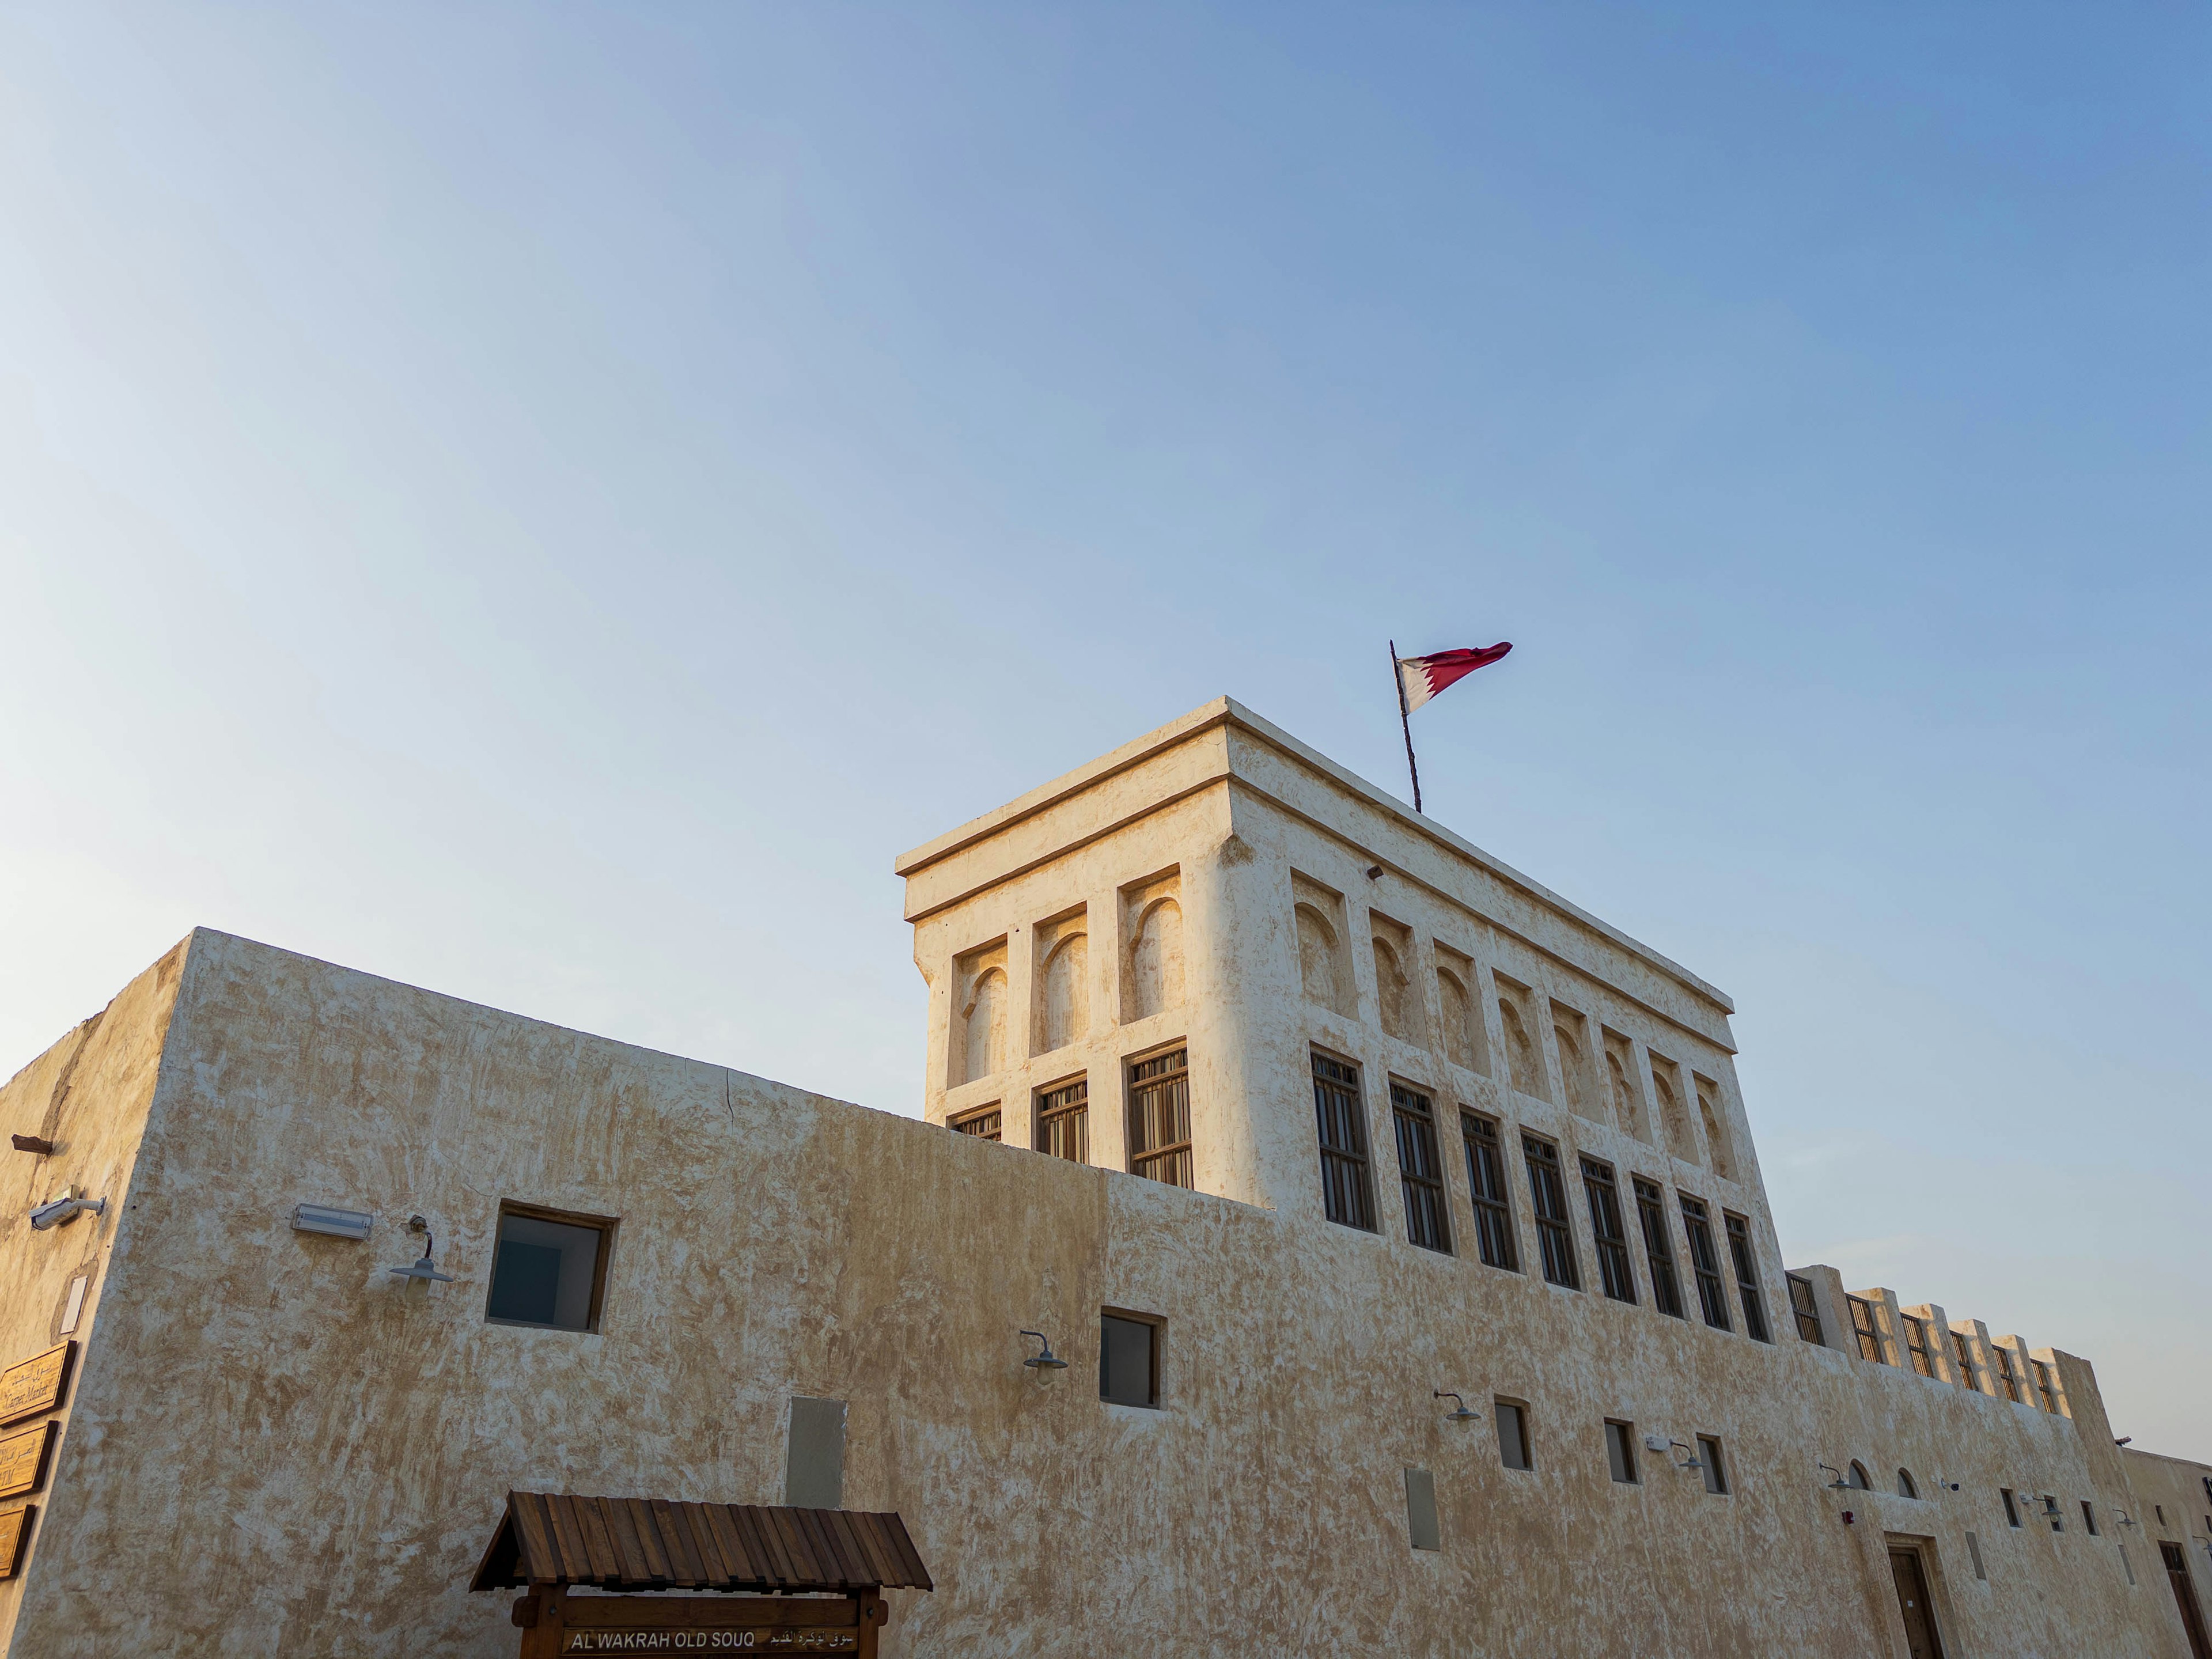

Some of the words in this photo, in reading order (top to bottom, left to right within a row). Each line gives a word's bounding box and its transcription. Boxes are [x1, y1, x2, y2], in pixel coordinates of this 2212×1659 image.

[0, 1468, 16, 1486] TM
[571, 1633, 593, 1649] AL
[598, 1632, 669, 1649] WAKRAH
[675, 1632, 707, 1647] OLD
[711, 1631, 755, 1647] SOUQ
[829, 1633, 853, 1647] سوق
